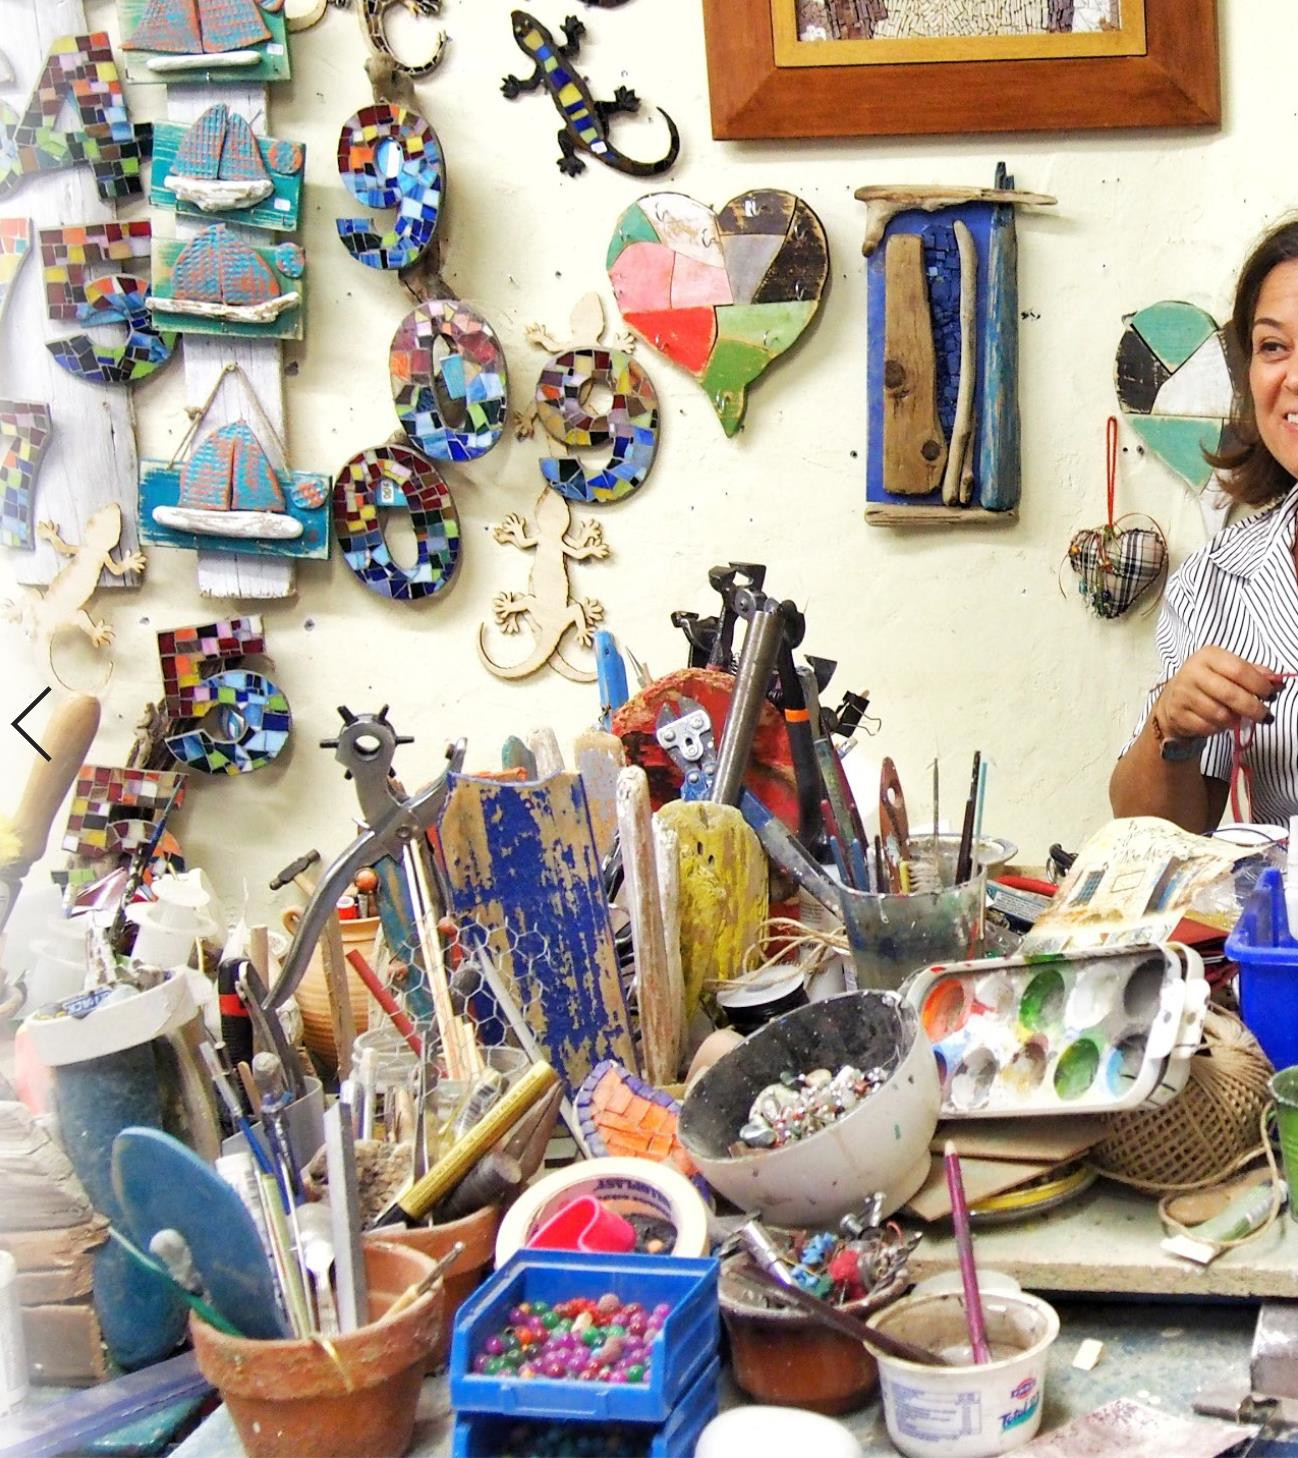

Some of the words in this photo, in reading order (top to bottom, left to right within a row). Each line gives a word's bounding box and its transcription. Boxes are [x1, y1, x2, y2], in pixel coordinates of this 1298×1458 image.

[336, 103, 446, 270] 9
[38, 221, 184, 383] 5
[535, 347, 661, 507] 9
[157, 614, 292, 776] 5
